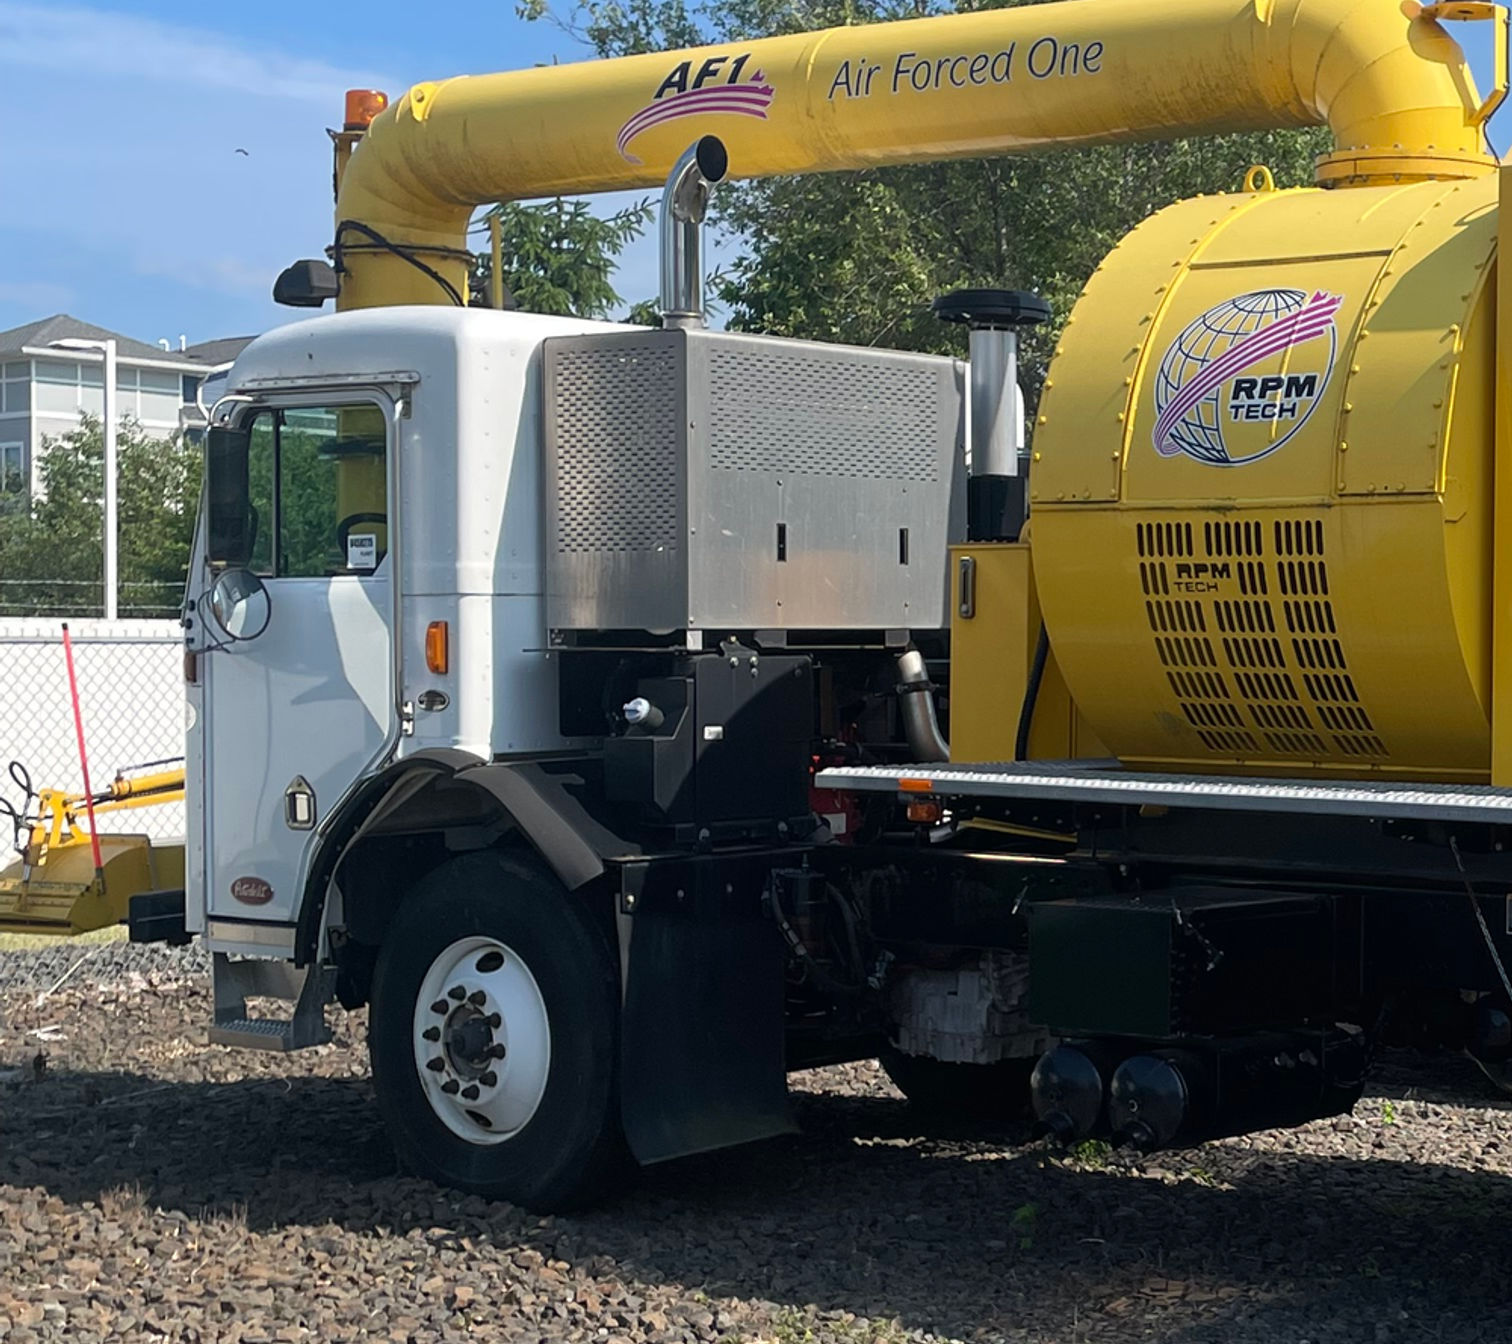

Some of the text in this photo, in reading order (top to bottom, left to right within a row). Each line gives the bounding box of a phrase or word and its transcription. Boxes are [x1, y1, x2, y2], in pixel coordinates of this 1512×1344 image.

[654, 53, 752, 100] AF1
[828, 36, 1104, 100] Air Forced One
[1231, 374, 1318, 401] RPM
[1229, 401, 1298, 420] TECH
[1176, 562, 1232, 579] RPM
[1173, 581, 1219, 593] TECH
